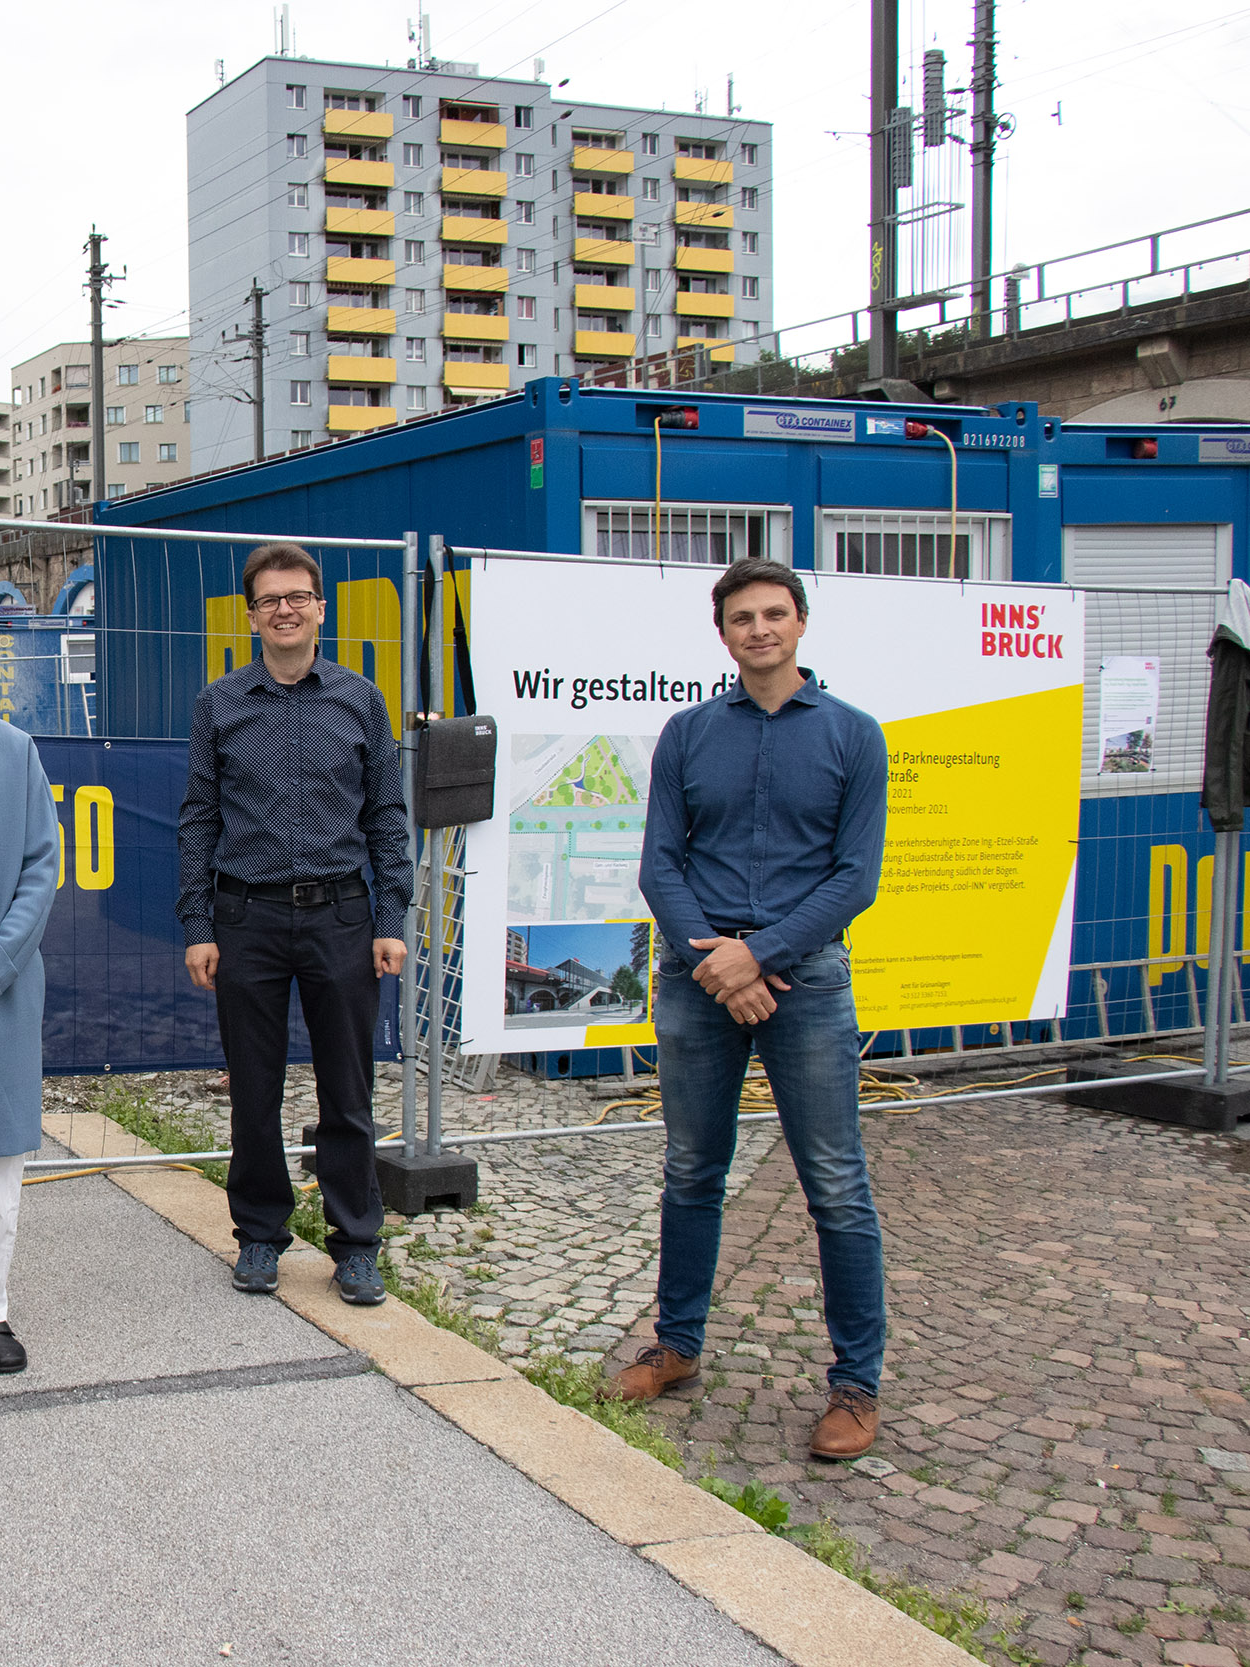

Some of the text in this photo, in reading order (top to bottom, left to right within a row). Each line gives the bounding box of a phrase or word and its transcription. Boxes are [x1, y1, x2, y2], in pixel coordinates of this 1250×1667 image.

[1159, 397, 1176, 411] 67
[801, 417, 852, 428] CONTAINEX
[963, 433, 1025, 448] 021692208
[981, 602, 1045, 629] INNS'
[981, 632, 1064, 660] BRUCK
[513, 668, 564, 700] Wir
[570, 671, 702, 710] gestalten
[902, 751, 1000, 768] Parkneugestaltung
[892, 788, 913, 799] 2021
[887, 804, 948, 815] November 2021
[895, 837, 960, 849] verkehrsberuhigte
[961, 837, 980, 847] Zone
[981, 835, 1039, 848] Ing.-Etzel-Straße
[883, 850, 1024, 865] dung Claudiastraße bis zur Bienerstraße
[955, 866, 981, 876] südlich
[982, 866, 994, 876] der
[995, 865, 1019, 877] Bögen.
[886, 883, 905, 895] Zuge
[906, 882, 919, 892] des
[920, 881, 950, 893] Projekts
